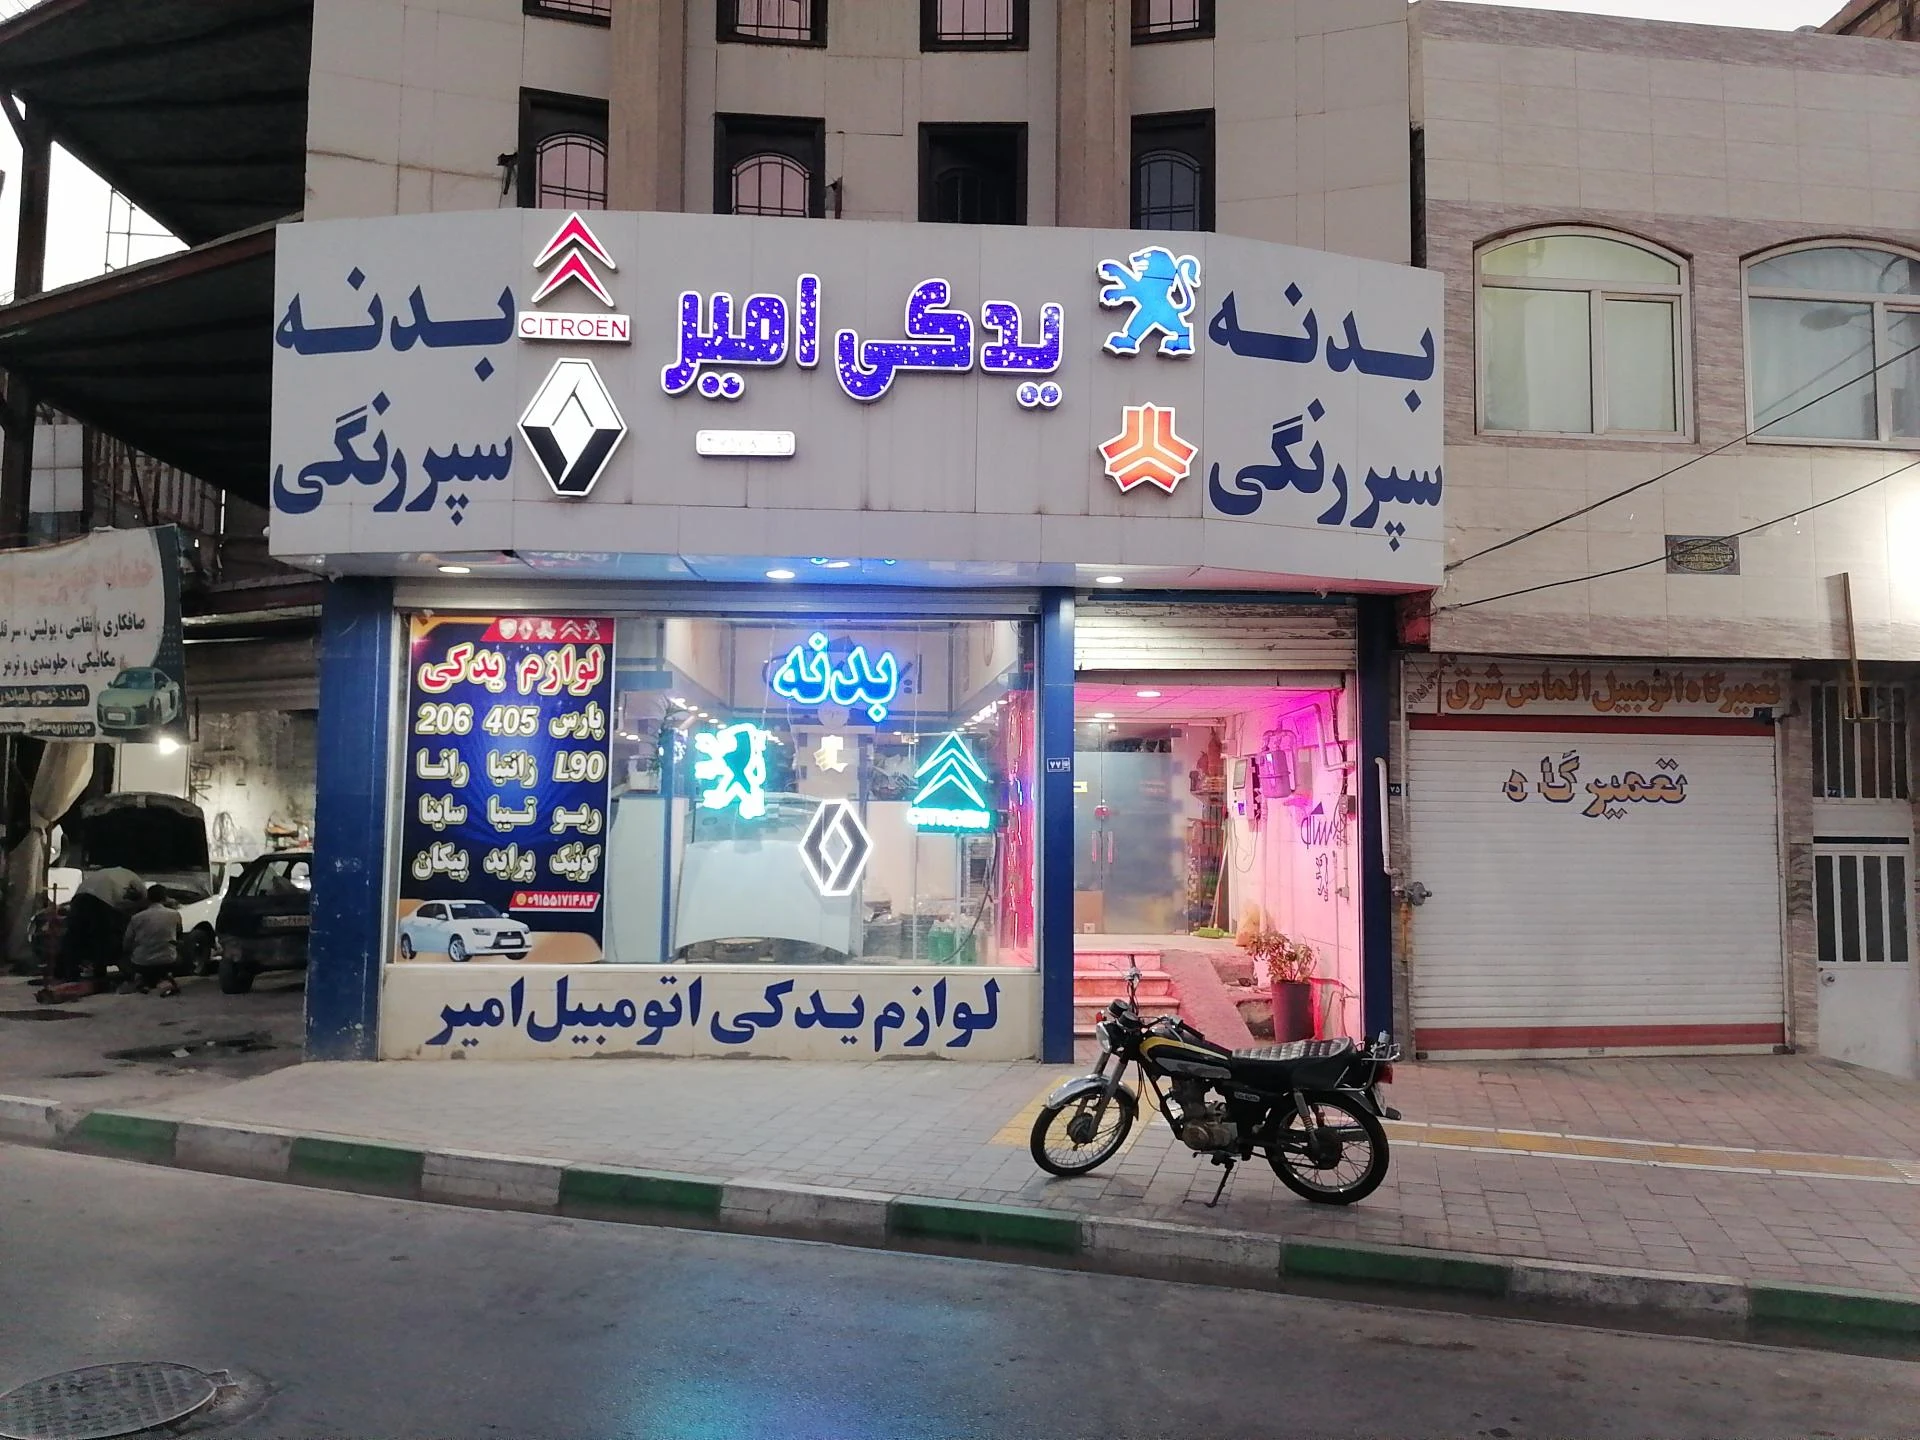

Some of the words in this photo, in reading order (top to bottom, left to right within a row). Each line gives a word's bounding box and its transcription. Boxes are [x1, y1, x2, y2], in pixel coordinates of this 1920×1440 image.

[275, 266, 516, 382] بدنه
[661, 273, 821, 399] امیر
[834, 277, 1064, 409] یدکی
[1207, 281, 1435, 413] بدنه
[103, 613, 145, 637] صافکاری
[78, 650, 115, 674] مکانیکی
[416, 641, 507, 694] یدکی
[517, 644, 605, 696] لوازم
[773, 631, 898, 723] بدنه
[1446, 662, 1504, 710] شرق
[1505, 667, 1591, 709] الماس
[1592, 668, 1684, 713] اتومبیل
[415, 703, 473, 735] 206
[482, 704, 540, 737] 405
[549, 701, 605, 741] پارس
[415, 747, 470, 787] رانا
[486, 747, 538, 787] زانتیا
[552, 751, 607, 783] L90
[419, 793, 467, 832] ساینا
[488, 796, 539, 831] تیبا
[551, 803, 602, 834] ریو
[412, 841, 470, 882] پیکان
[482, 842, 537, 882] پراید
[425, 975, 525, 1048] امیر
[526, 975, 702, 1047] اتومبیل
[710, 978, 865, 1046] یدکی
[872, 976, 1001, 1052] لوازم
